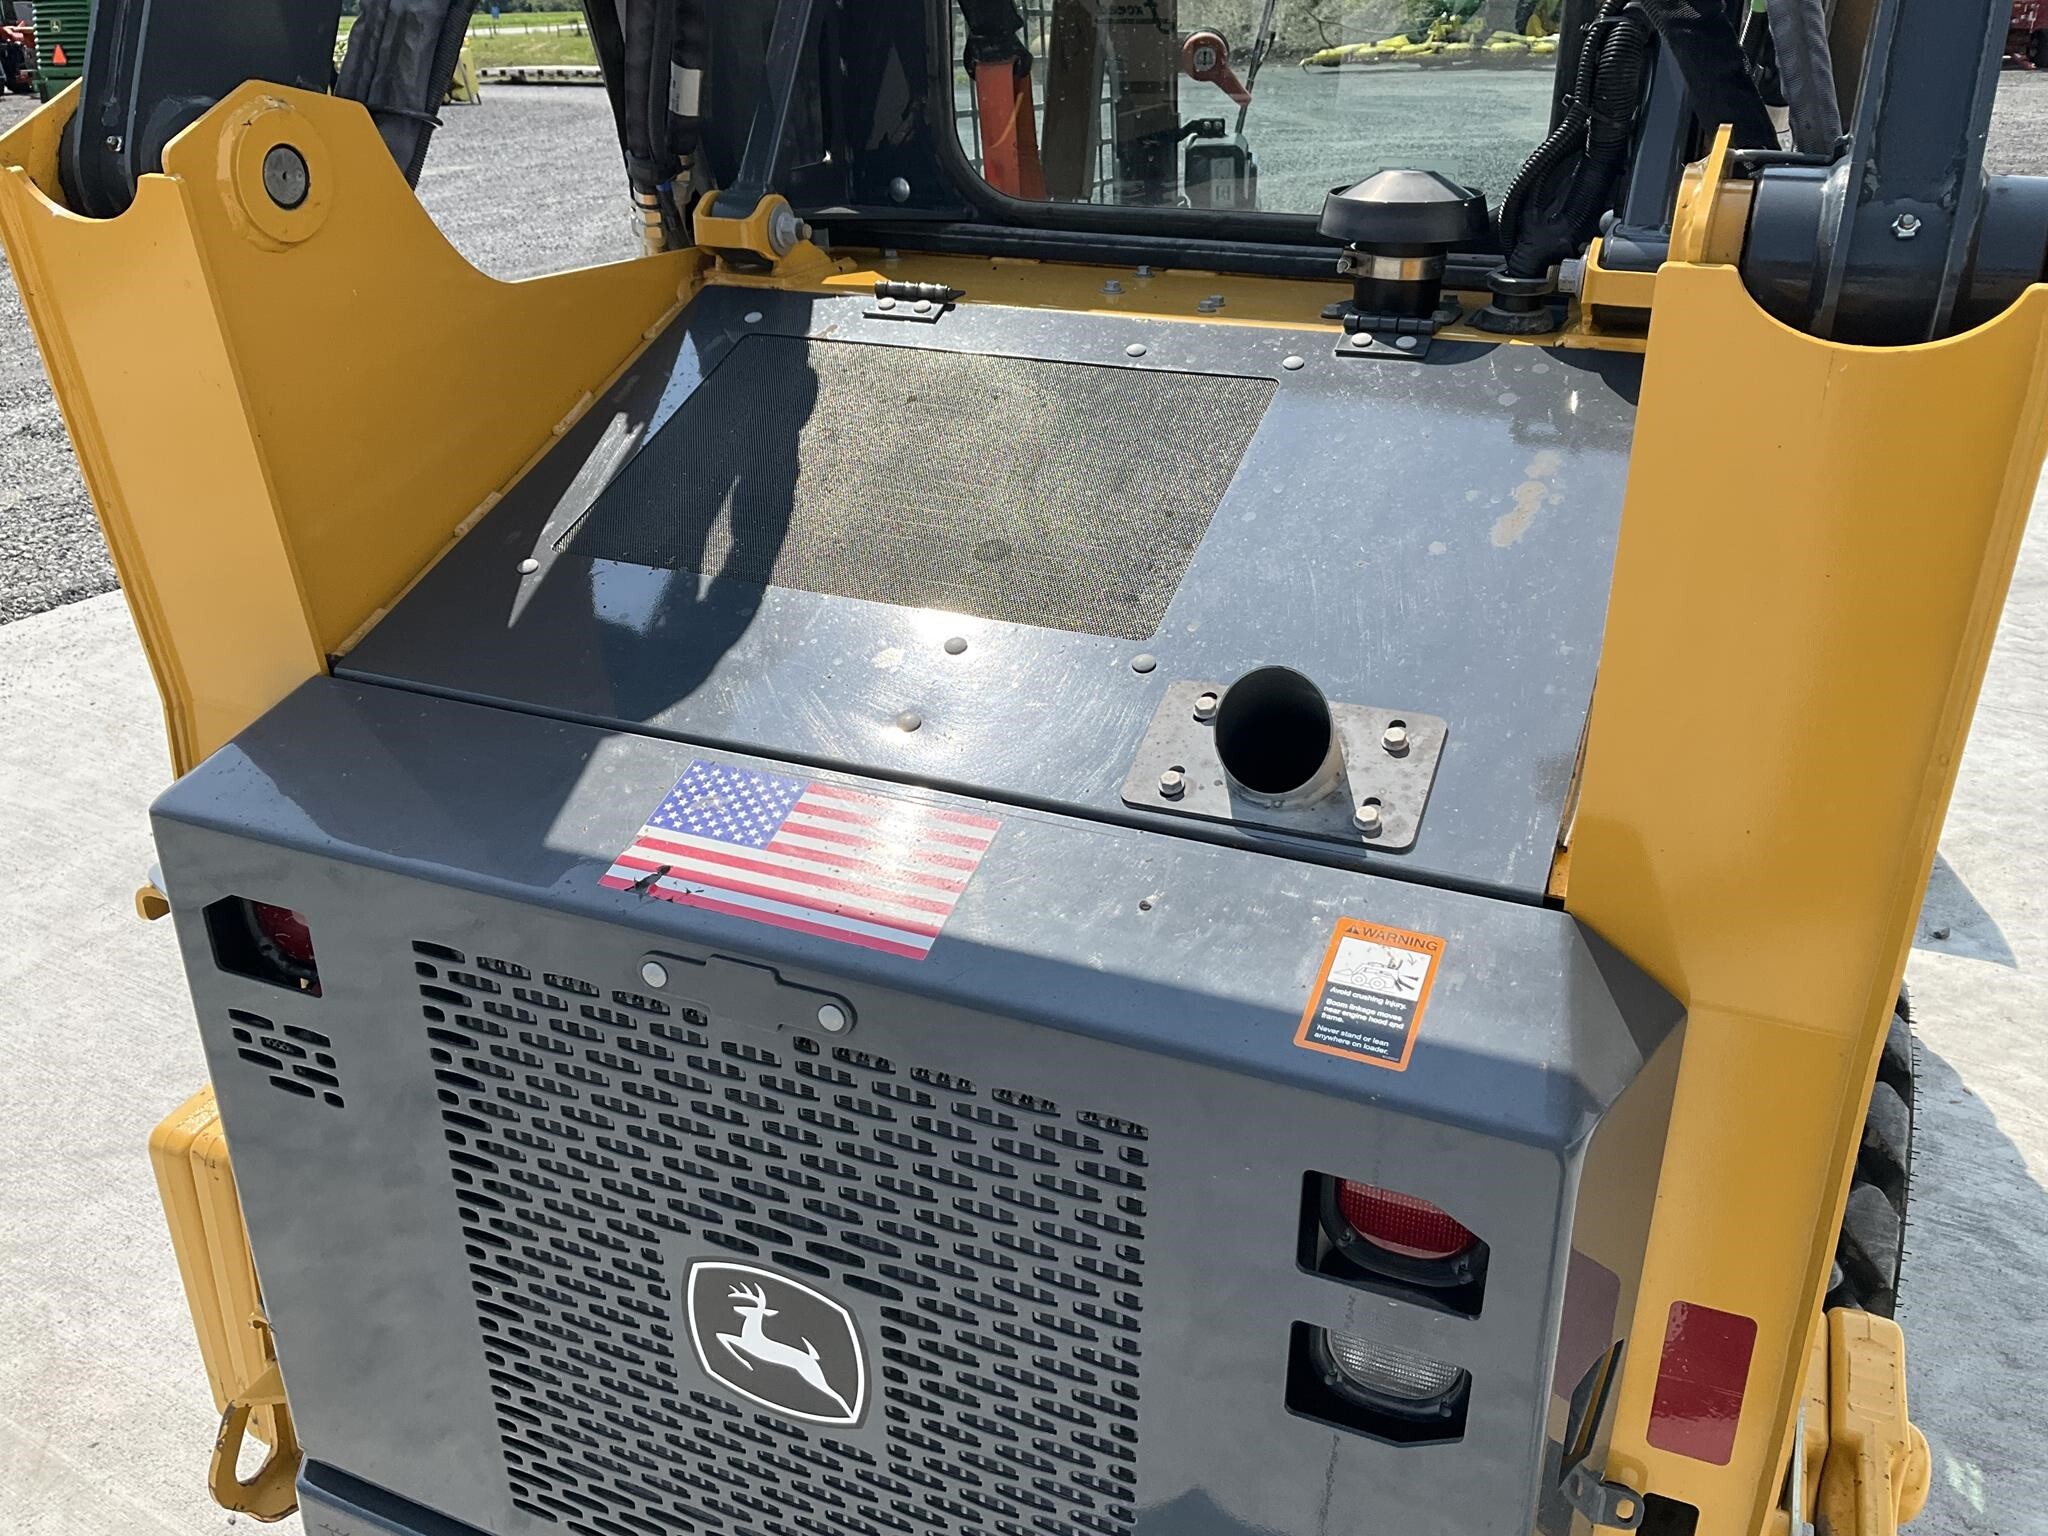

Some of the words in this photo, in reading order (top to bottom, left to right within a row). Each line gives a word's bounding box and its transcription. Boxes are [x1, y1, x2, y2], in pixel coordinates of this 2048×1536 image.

[1363, 928, 1438, 951] WARNING
[1330, 987, 1352, 996] Avoid
[1352, 992, 1384, 1005] crushing
[1321, 1013, 1344, 1022] frame.
[1324, 1007, 1341, 1015] near
[1342, 1011, 1367, 1022] engine
[1368, 1015, 1388, 1025] hood
[1389, 1021, 1405, 1030] and
[1326, 998, 1348, 1010] Boom
[1349, 1003, 1377, 1016] linkage
[1377, 1011, 1403, 1021] moves
[1314, 1032, 1350, 1045] anywhere
[1351, 1040, 1362, 1048] on
[1363, 1042, 1389, 1054] loader.
[1316, 1025, 1340, 1034] Never
[1340, 1030, 1361, 1039] stand
[1362, 1034, 1372, 1042] or
[1372, 1037, 1389, 1046] lean
